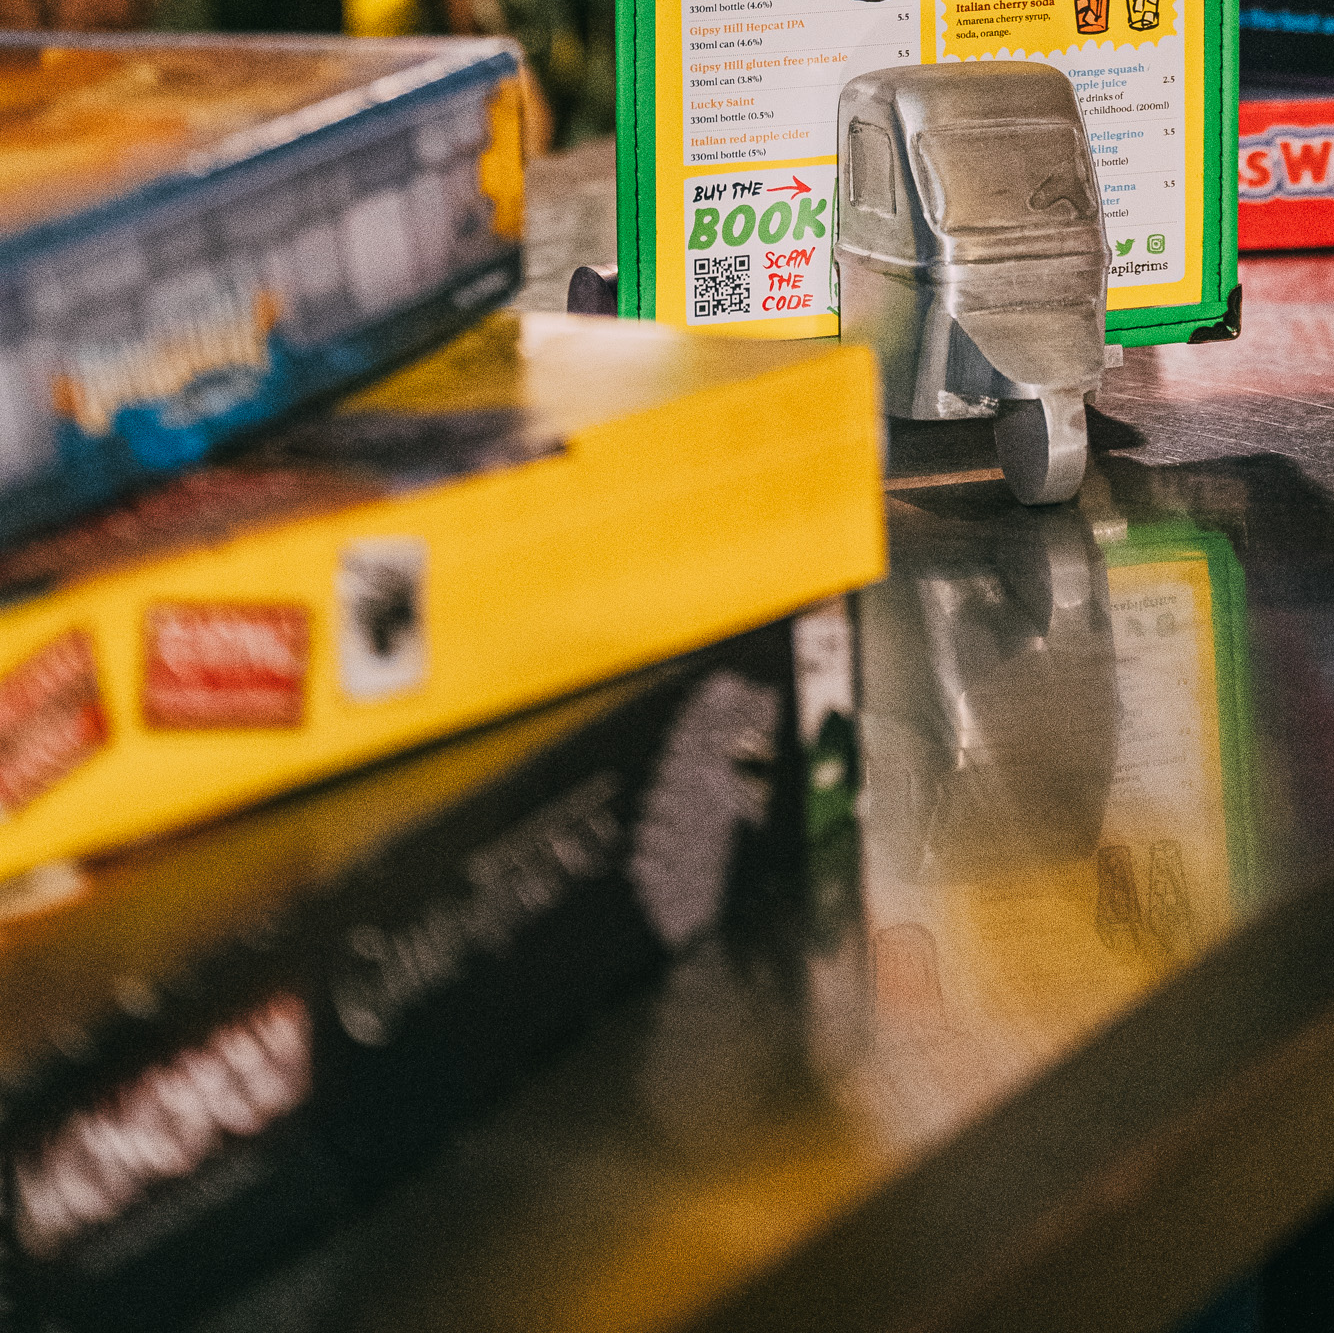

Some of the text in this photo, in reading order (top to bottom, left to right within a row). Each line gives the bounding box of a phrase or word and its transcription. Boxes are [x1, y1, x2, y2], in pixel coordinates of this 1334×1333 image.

[689, 0, 773, 14] 330ml bottle (4.6%)
[956, 1, 991, 13] Italian
[992, 0, 1028, 10] cherry
[689, 12, 909, 37] Gipsy Hill Hepcat IPA 5.5
[956, 13, 1051, 26] Amarena cherry syrup,
[955, 29, 1011, 39] soda, orange.
[689, 37, 763, 50] 330ml can (4.6%)
[898, 49, 910, 58] 5.5
[1068, 63, 1145, 78] Orange squash
[1101, 76, 1175, 90] juice 2.5
[690, 97, 754, 110] Lucky Saint
[1086, 93, 1113, 103] drinks
[1115, 92, 1124, 100] of
[1089, 104, 1134, 115] childhood.
[1136, 101, 1169, 112] (200ml)
[690, 110, 774, 125] 330ml bottle (0.5%)
[1090, 128, 1175, 141] Pellegrino 3.5
[1102, 157, 1128, 167] bottle)
[693, 180, 763, 203] BUY THE
[1104, 180, 1176, 192] Panna 3.5
[688, 197, 827, 250] BOOK
[763, 246, 815, 269] SCAN
[1108, 261, 1168, 276] apilgrims
[768, 273, 804, 292] THE
[762, 294, 813, 311] CODE
